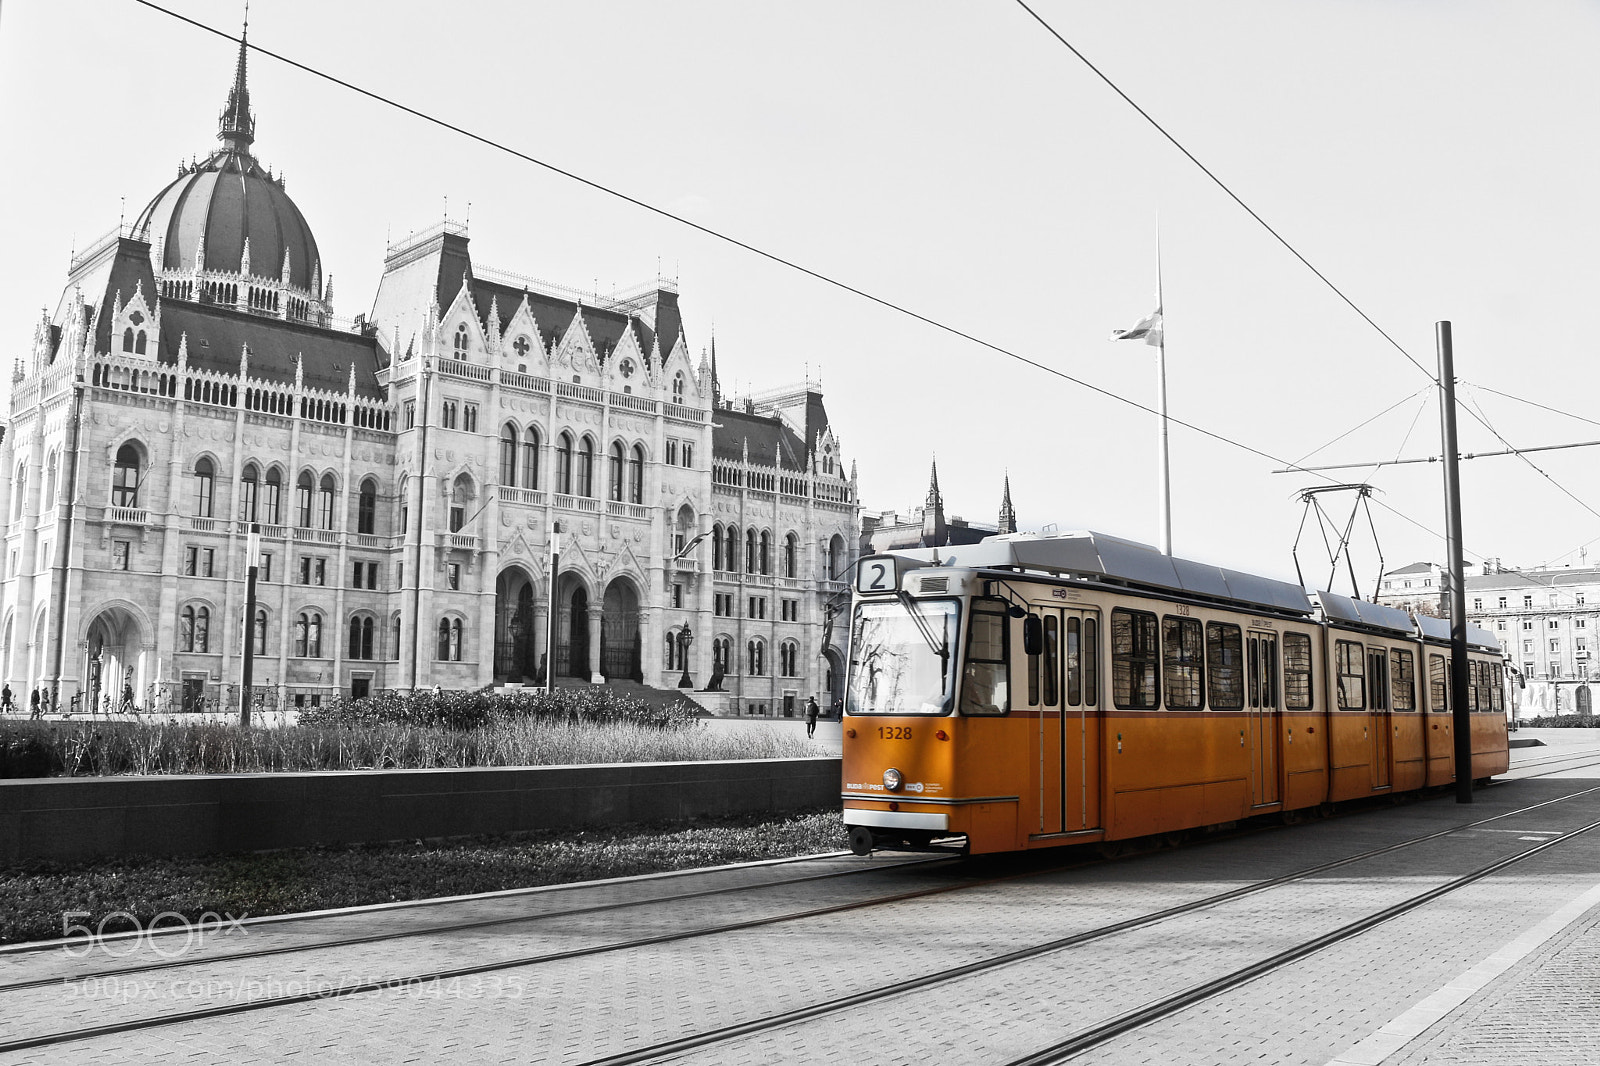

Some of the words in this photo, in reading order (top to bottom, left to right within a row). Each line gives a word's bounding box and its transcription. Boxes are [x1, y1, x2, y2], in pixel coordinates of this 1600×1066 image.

[870, 563, 886, 590] 2
[1175, 603, 1190, 616] 1328
[878, 726, 913, 740] 1328
